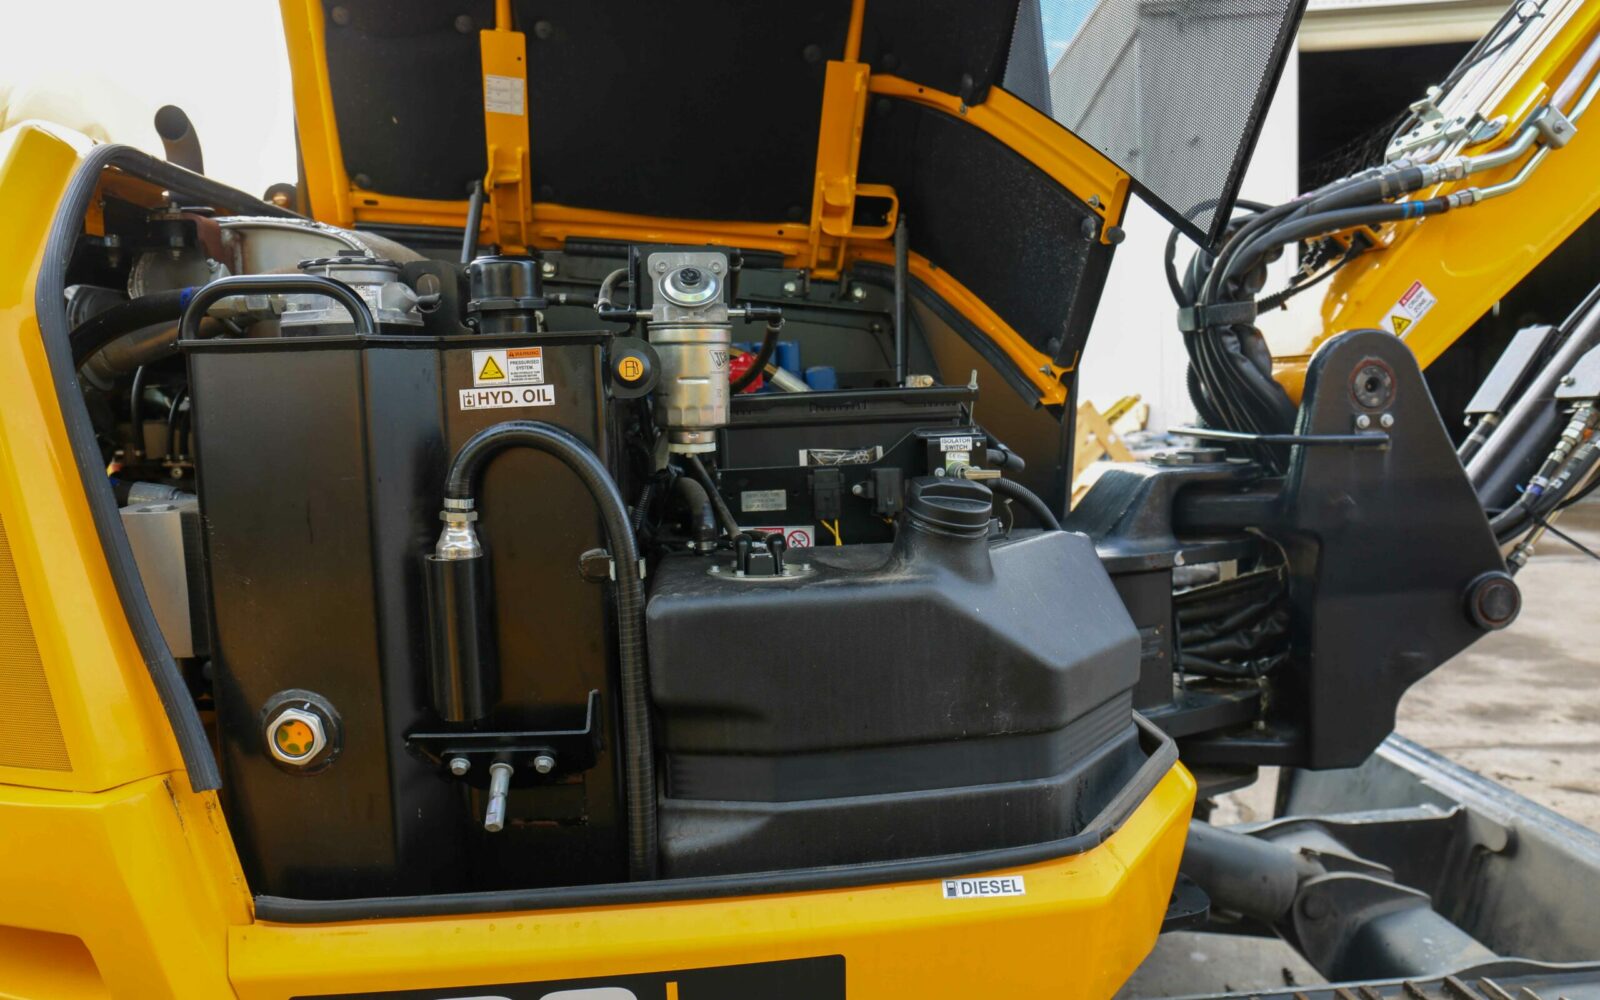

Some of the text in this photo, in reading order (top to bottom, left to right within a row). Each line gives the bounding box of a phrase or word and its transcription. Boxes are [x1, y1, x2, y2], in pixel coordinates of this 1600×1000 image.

[477, 388, 553, 406] HYD. OIL
[961, 879, 1022, 895] DIESEL
